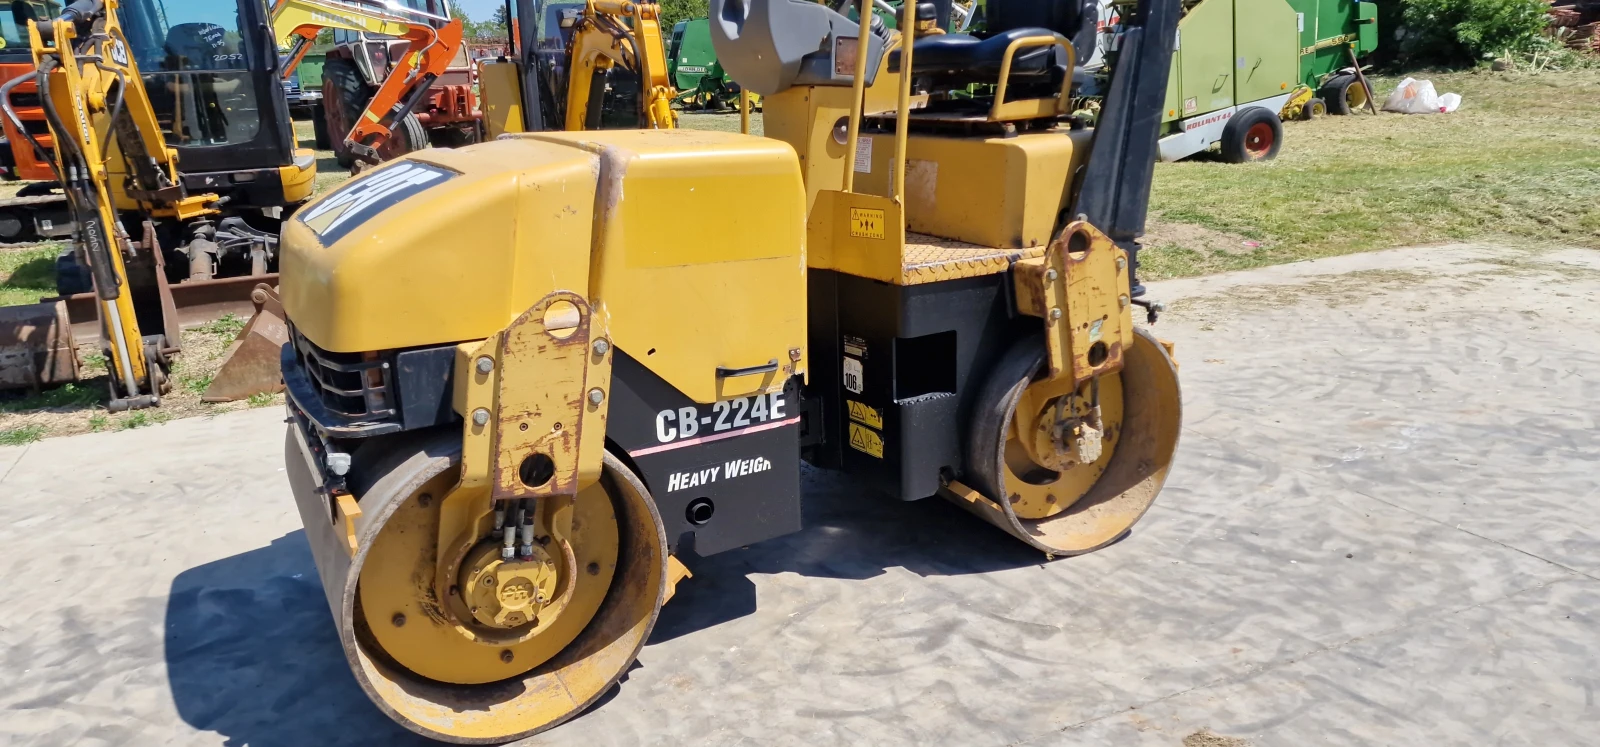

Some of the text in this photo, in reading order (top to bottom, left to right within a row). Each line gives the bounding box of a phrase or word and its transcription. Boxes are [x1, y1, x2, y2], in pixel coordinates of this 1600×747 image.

[311, 11, 367, 28] HITACHI
[213, 53, 243, 61] 2052
[1300, 47, 1309, 55] RE
[1186, 112, 1232, 130] ROLLANT 44
[303, 163, 444, 236] CAT
[845, 372, 857, 390] 106
[656, 393, 787, 443] CB-224E
[667, 466, 721, 492] HEAVY
